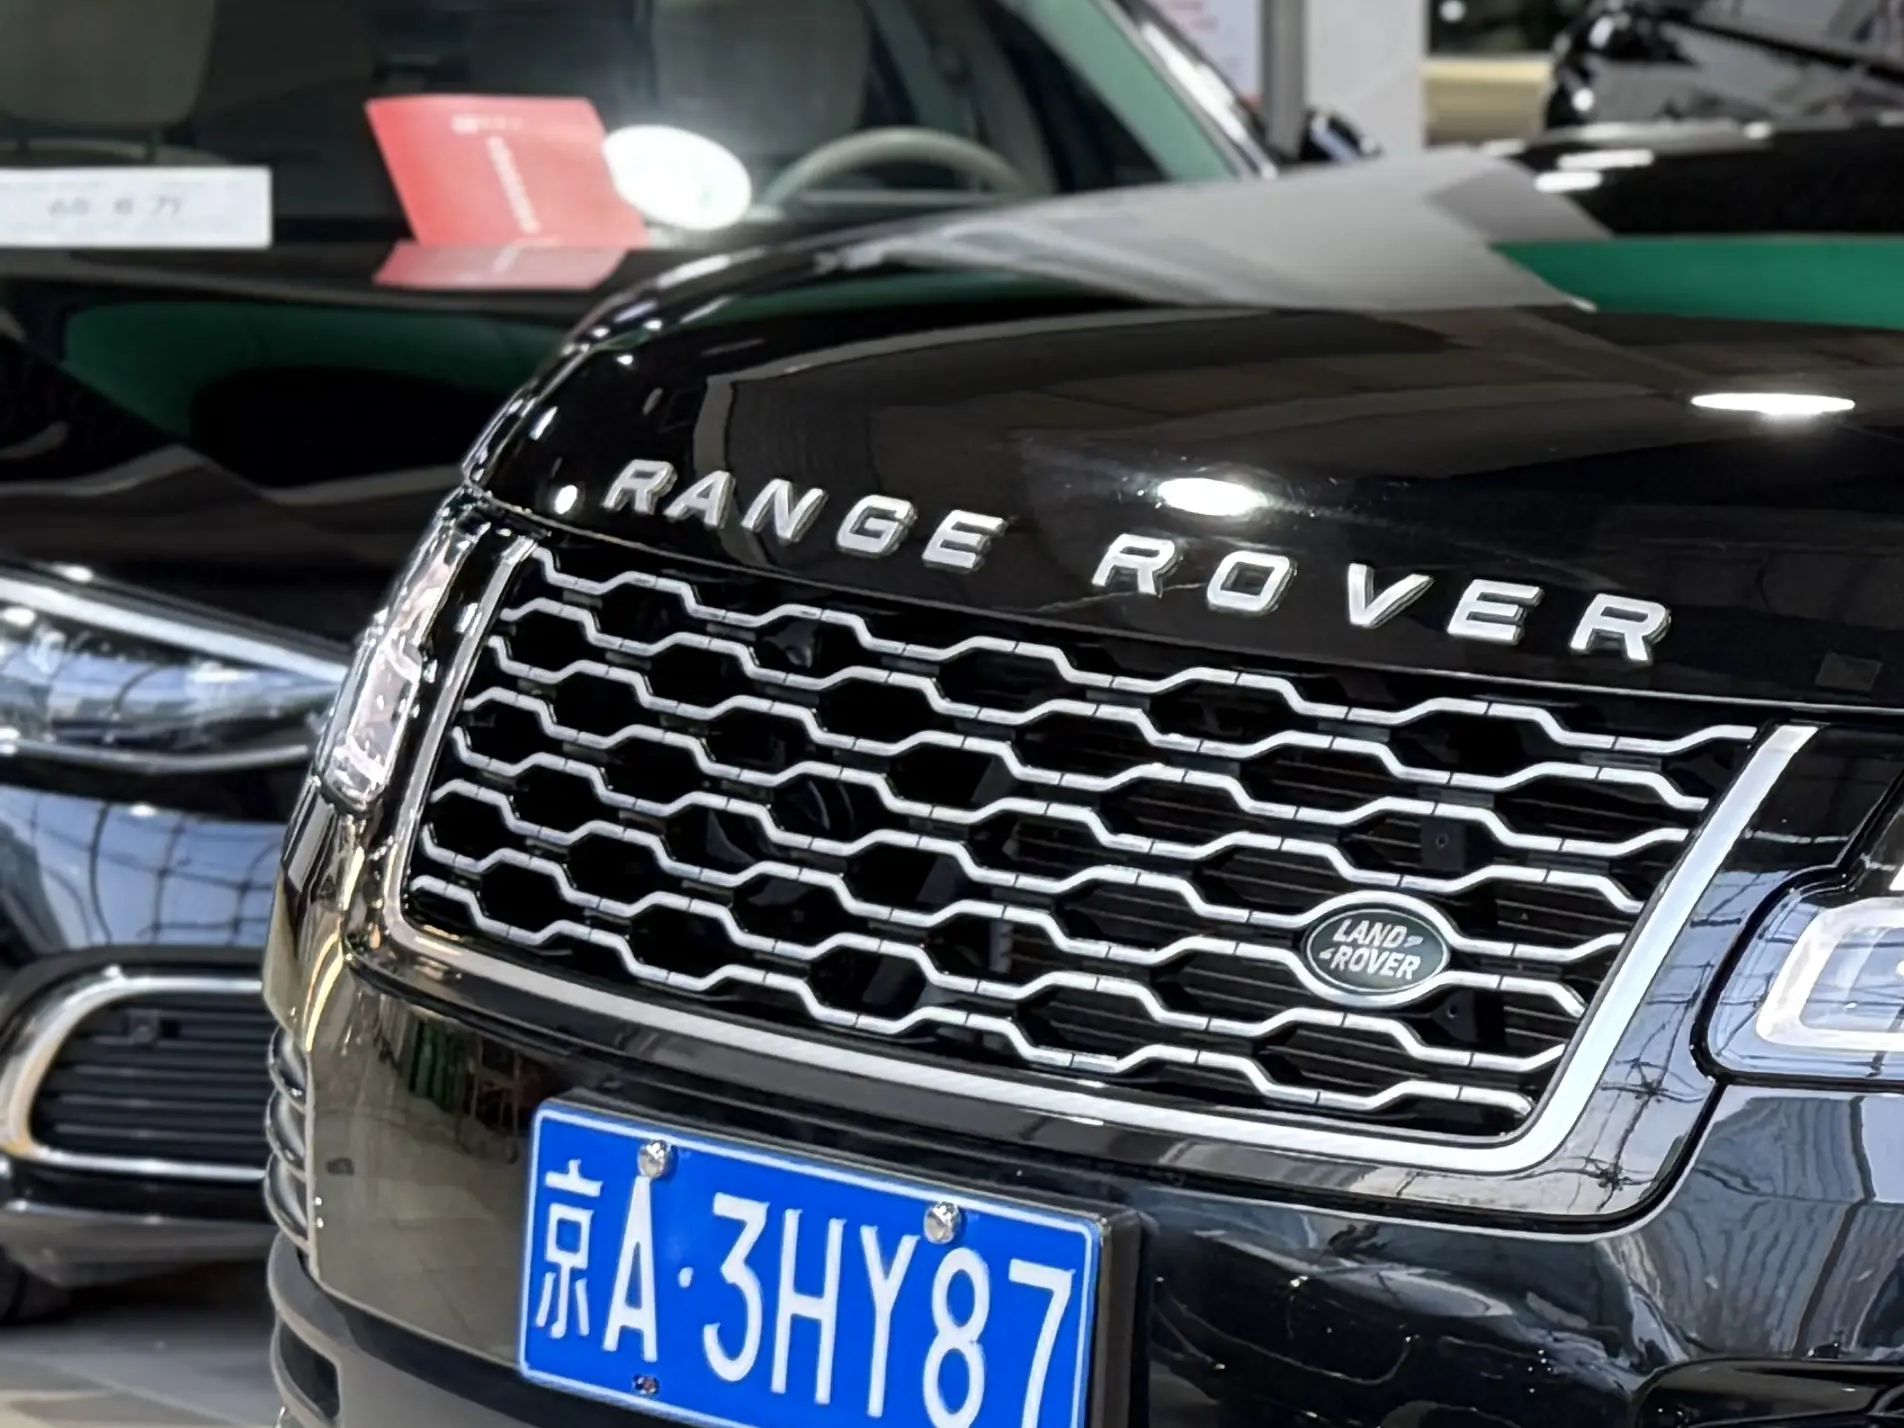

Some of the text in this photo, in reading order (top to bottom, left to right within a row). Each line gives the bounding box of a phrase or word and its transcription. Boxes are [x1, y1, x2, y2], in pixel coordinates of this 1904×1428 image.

[603, 458, 1674, 662] RANGE ROVER
[1332, 918, 1408, 949] LAND
[1330, 945, 1421, 981] ROVER
